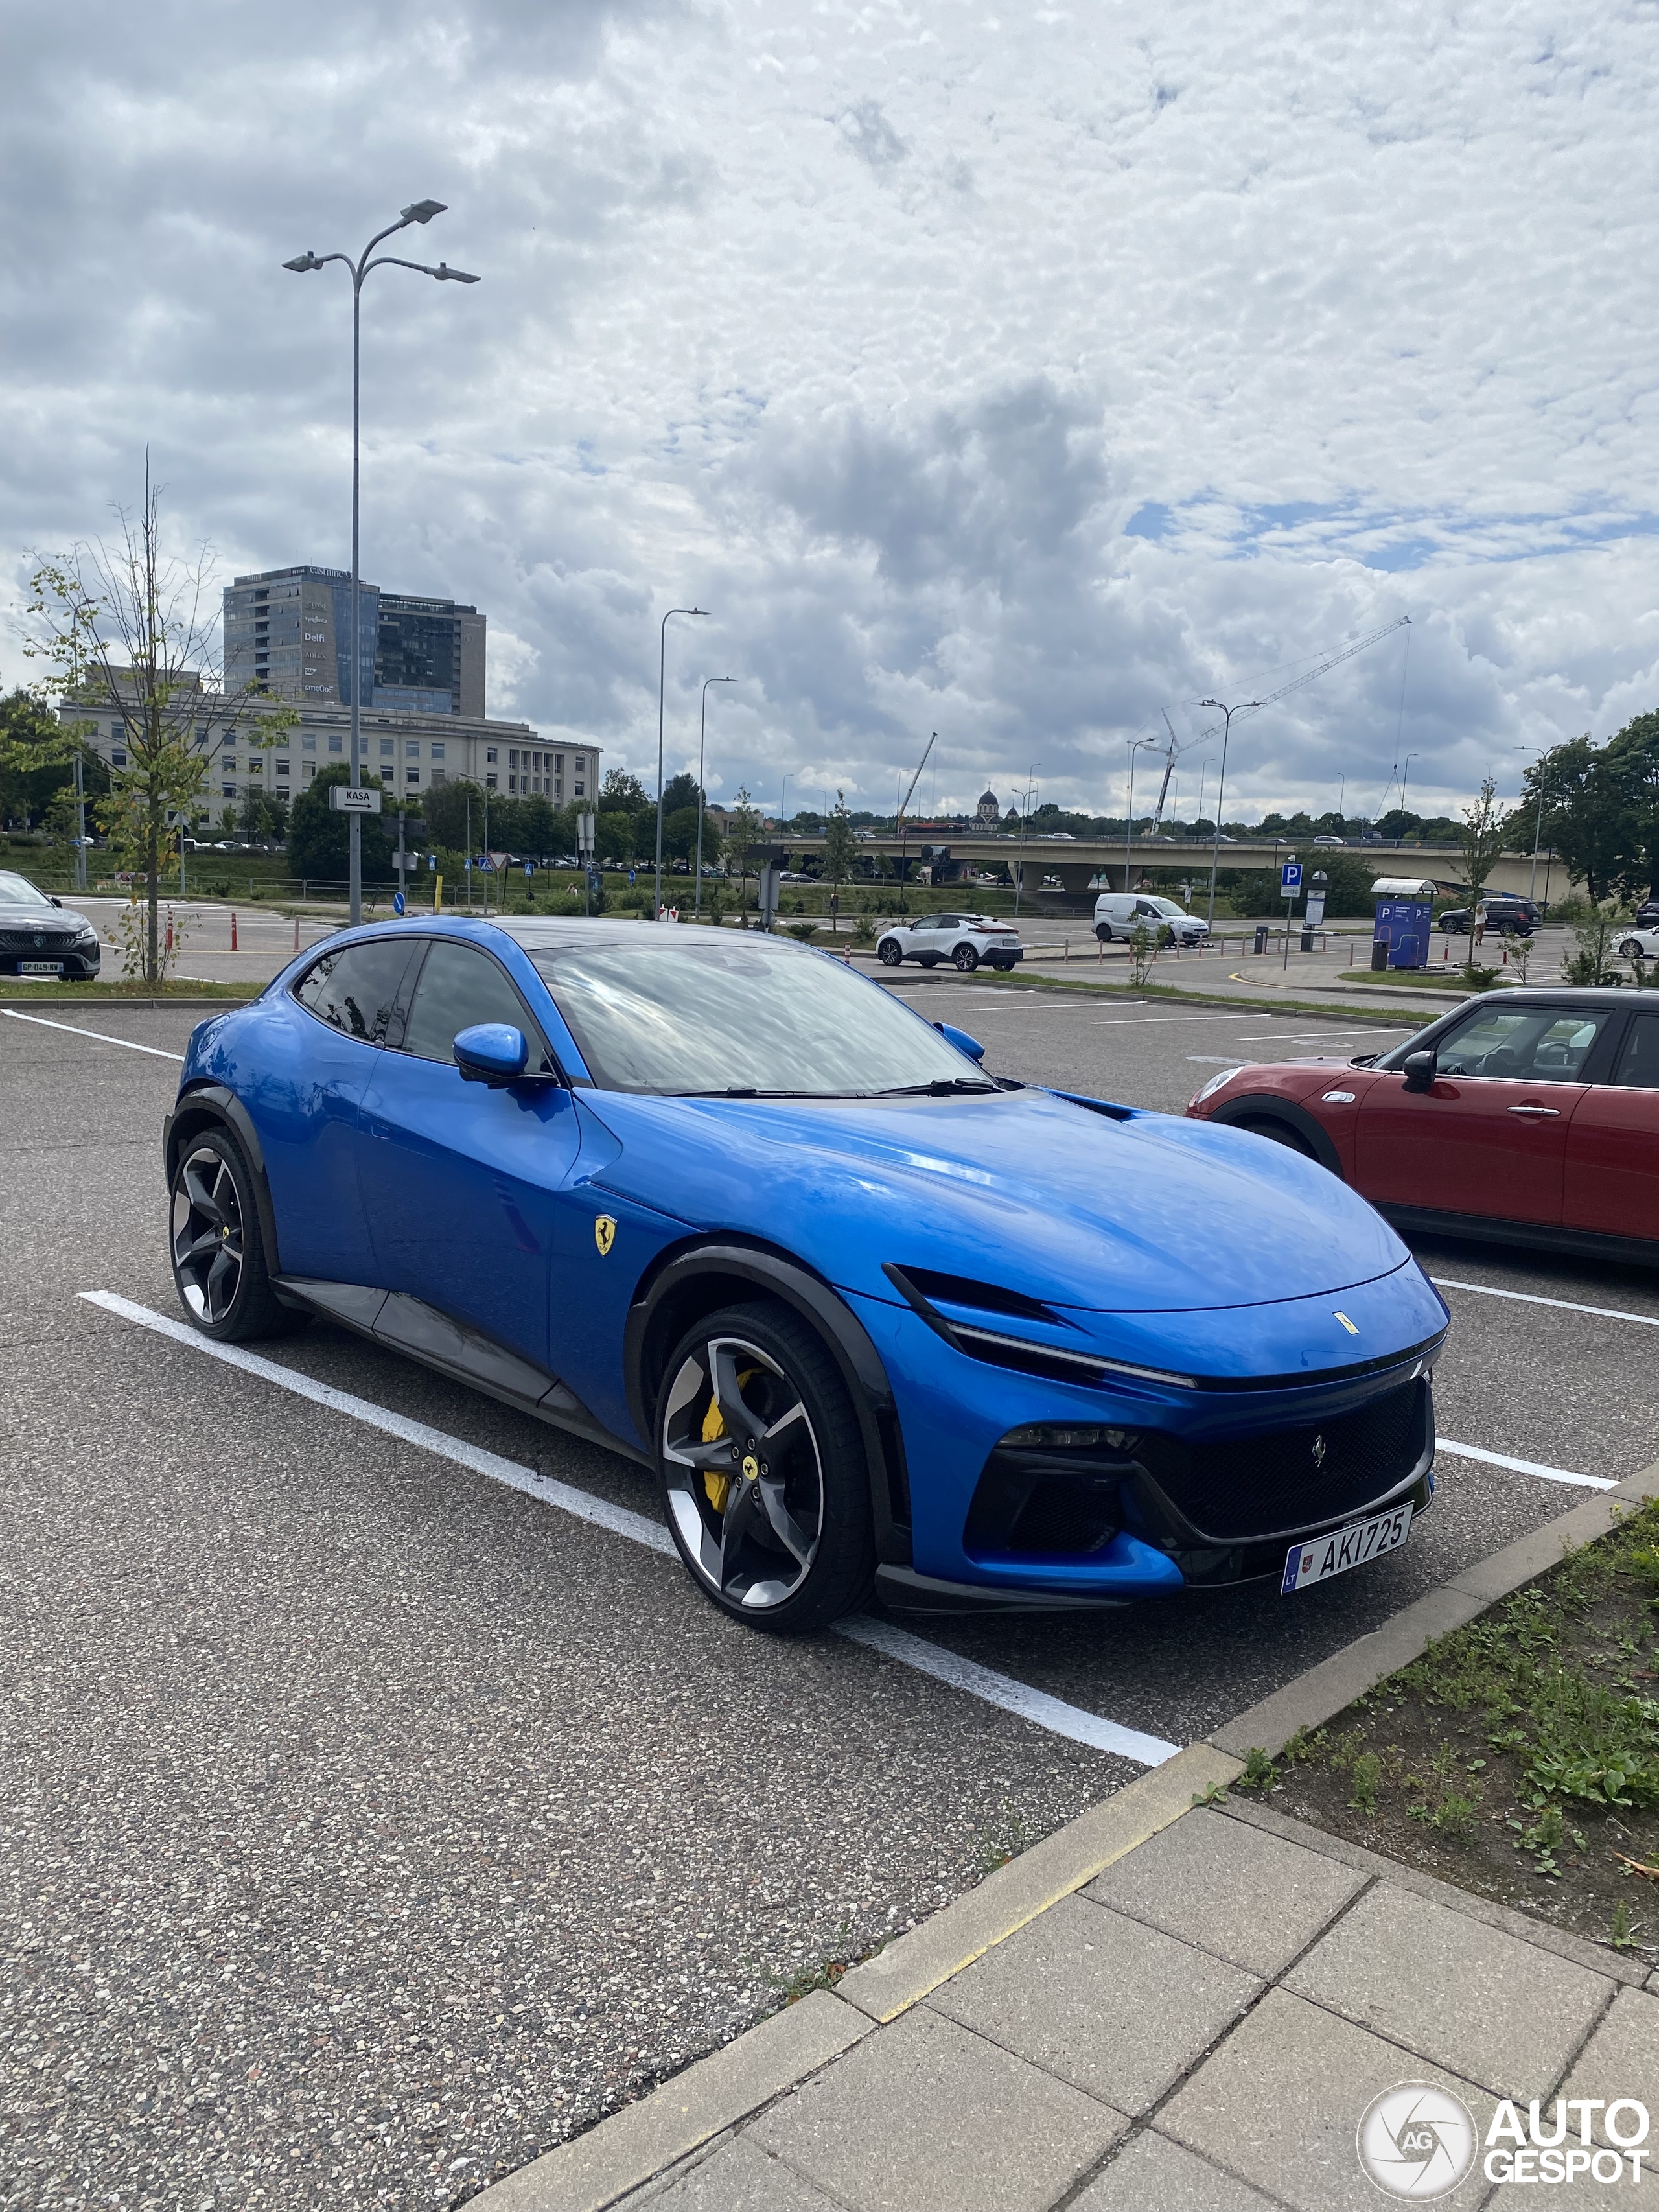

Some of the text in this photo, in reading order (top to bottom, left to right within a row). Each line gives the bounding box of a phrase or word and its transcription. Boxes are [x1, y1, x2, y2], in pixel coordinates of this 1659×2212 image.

[305, 633, 325, 642] Delfi
[346, 791, 370, 800] KASA
[1286, 867, 1298, 884] P
[1382, 907, 1390, 918] P
[1285, 1574, 1296, 1586] LT
